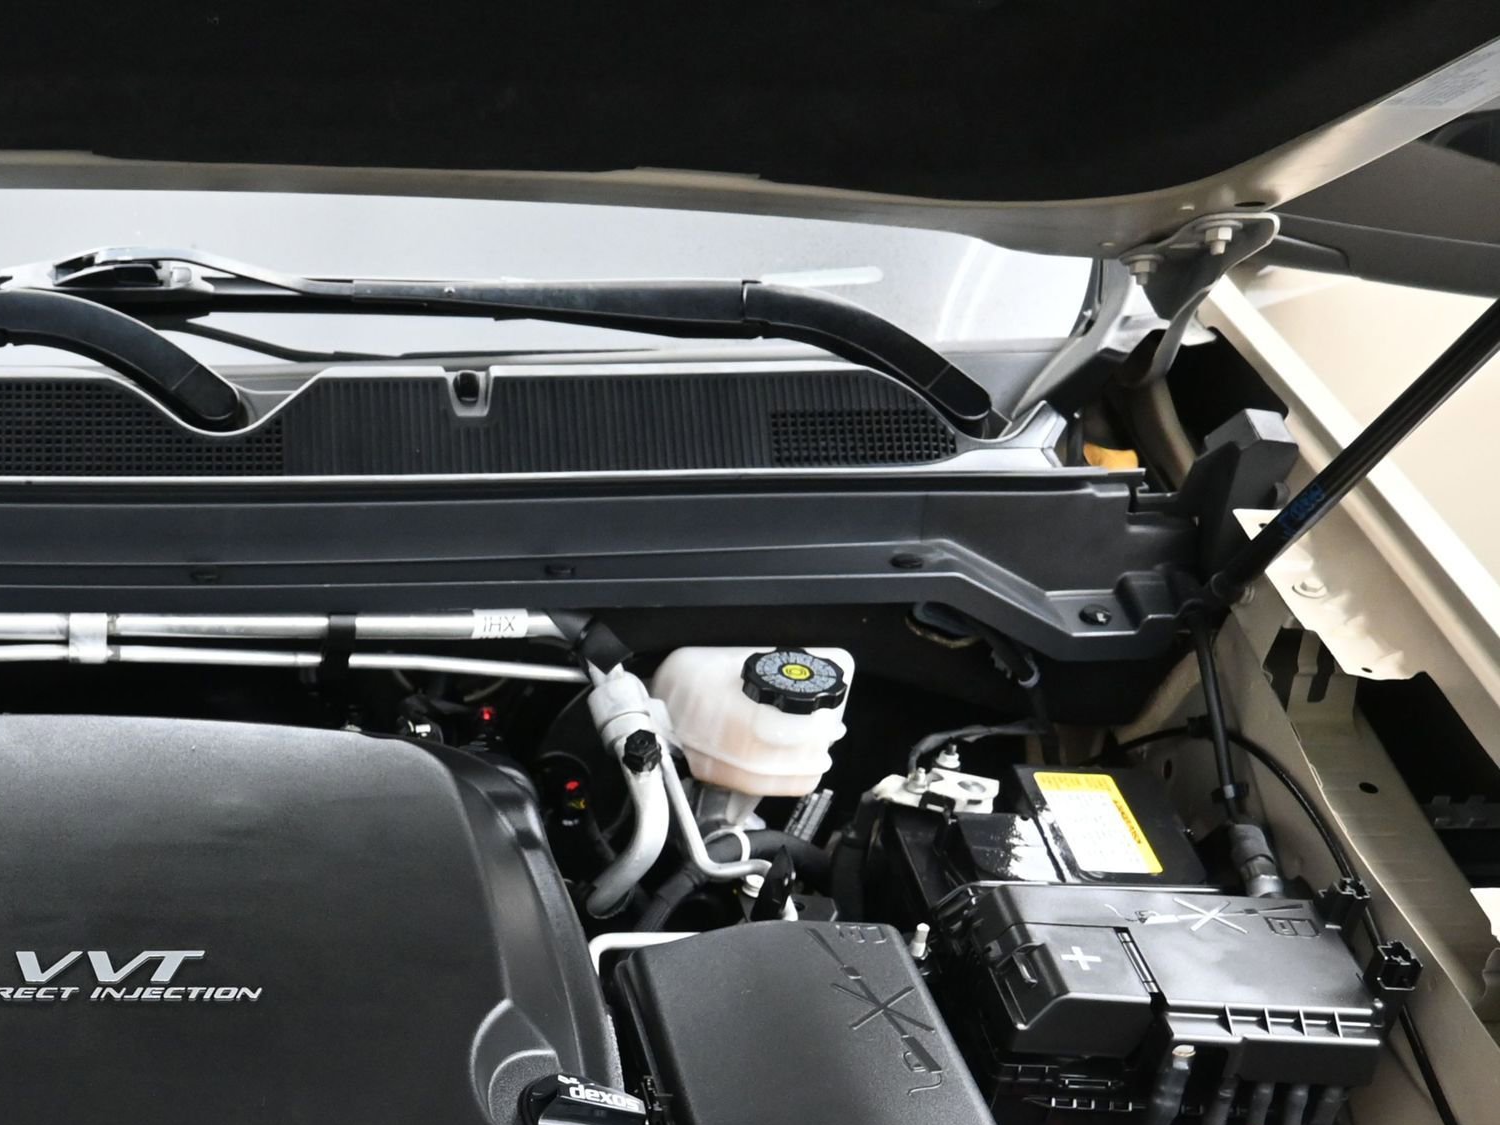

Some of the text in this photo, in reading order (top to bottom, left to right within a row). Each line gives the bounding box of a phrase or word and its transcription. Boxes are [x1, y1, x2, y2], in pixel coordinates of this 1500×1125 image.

[15, 950, 206, 985] VVT
[90, 986, 263, 1002] INJECTION
[568, 1084, 641, 1112] dexos
